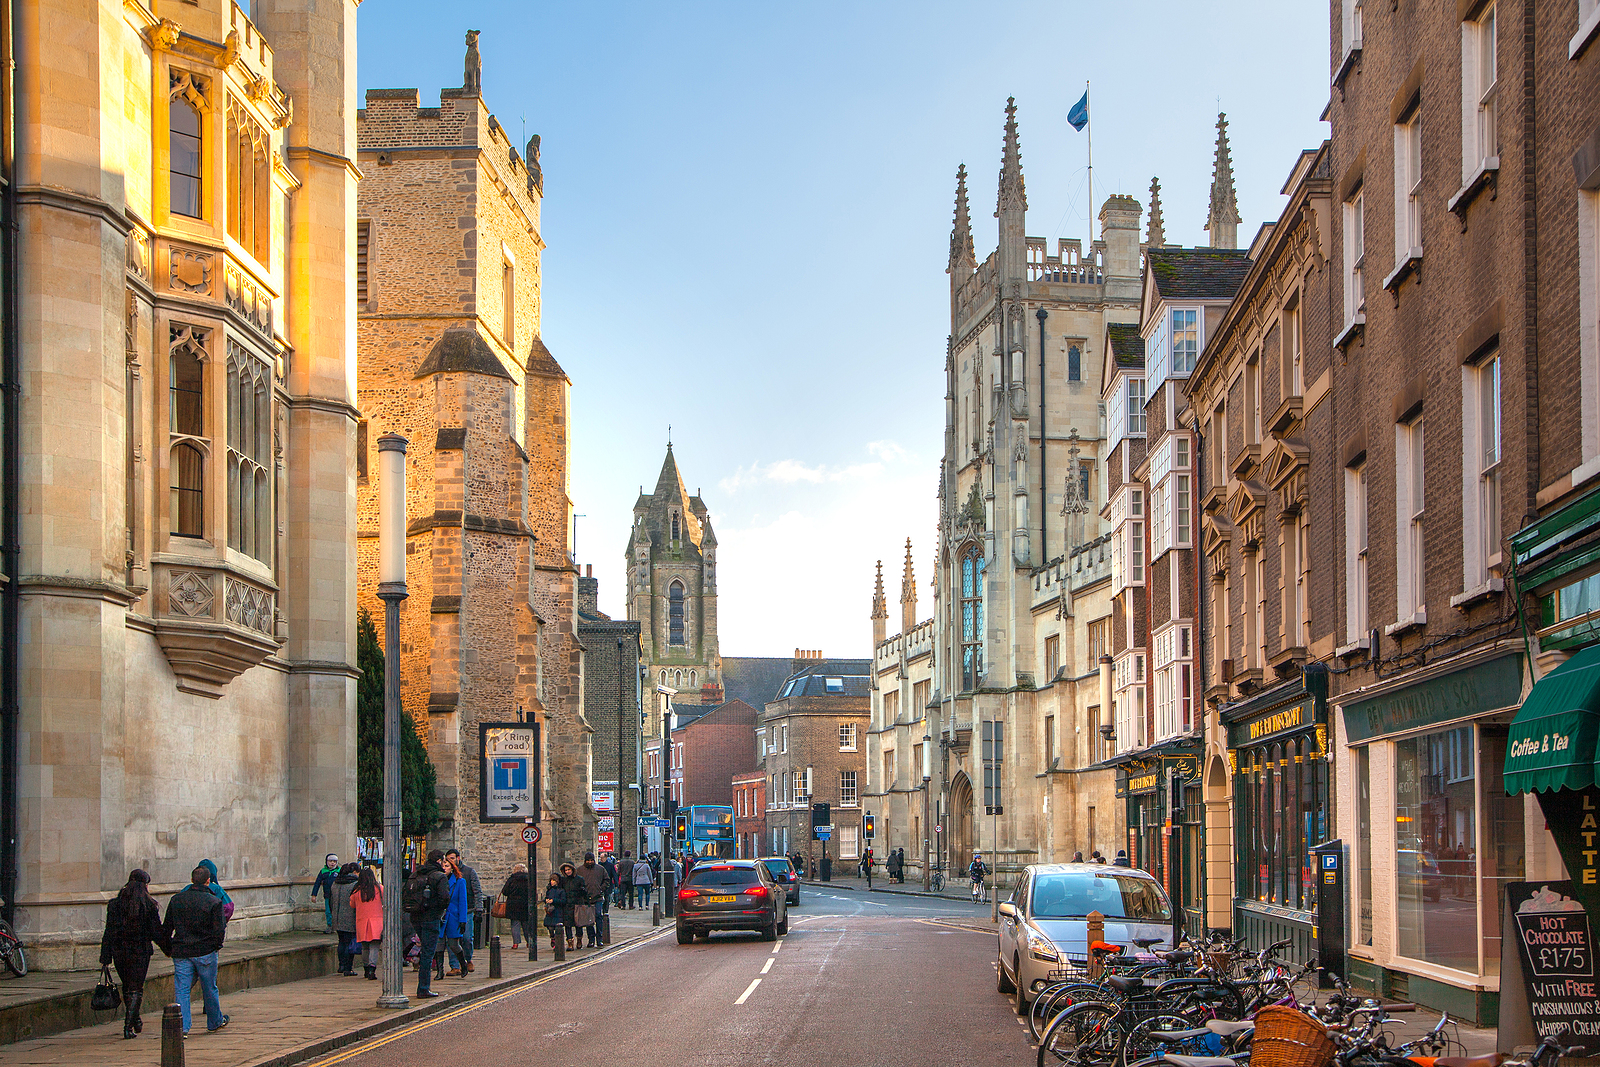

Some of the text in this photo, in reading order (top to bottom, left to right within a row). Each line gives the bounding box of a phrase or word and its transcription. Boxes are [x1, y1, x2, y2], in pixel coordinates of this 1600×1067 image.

[1510, 732, 1569, 758] Coffee & Tea
[493, 794, 514, 802] Except
[524, 830, 537, 839] 20
[1580, 795, 1597, 884] LATTE
[1326, 857, 1334, 867] P
[1540, 917, 1567, 930] HOT
[1525, 929, 1585, 945] CHOCOLATE
[1531, 979, 1597, 998] WITH FREE
[1532, 1001, 1593, 1016] MARSHMALLOWS
